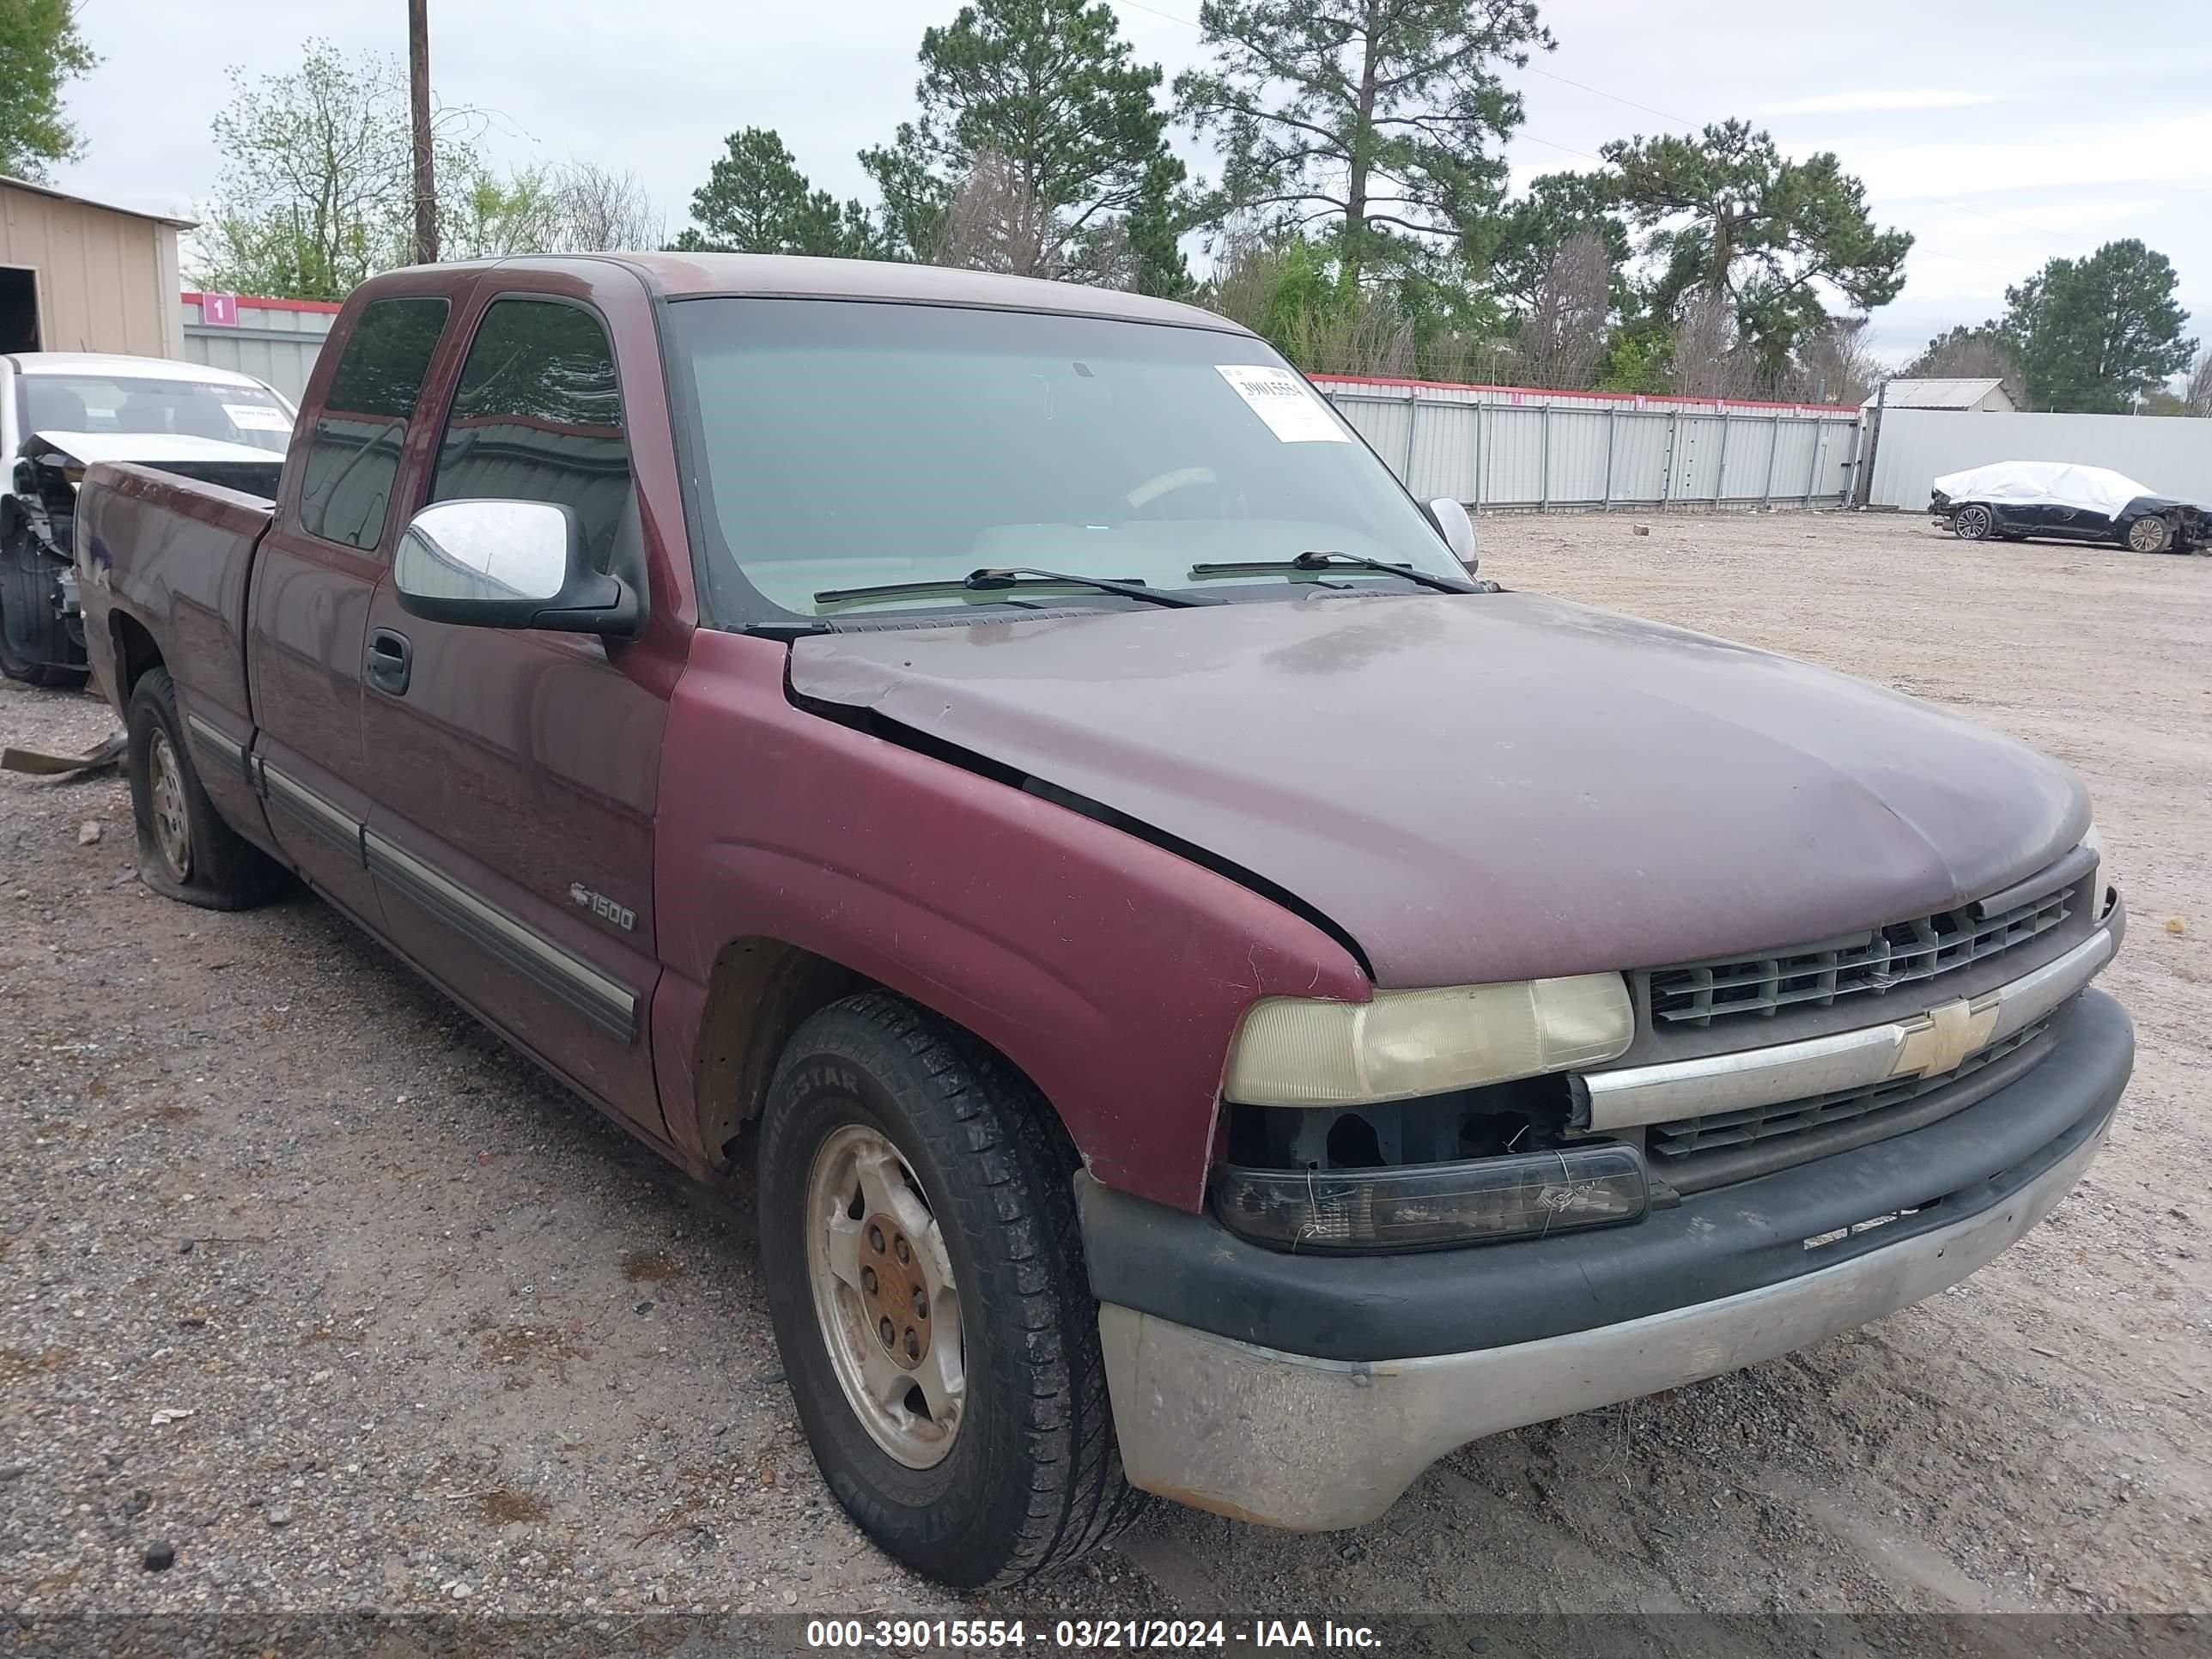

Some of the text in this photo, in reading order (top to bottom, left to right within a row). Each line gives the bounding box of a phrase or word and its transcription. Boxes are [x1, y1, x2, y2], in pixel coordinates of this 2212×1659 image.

[214, 299, 224, 319] 1
[1240, 381, 1305, 398] 39015554
[590, 894, 637, 931] 1500
